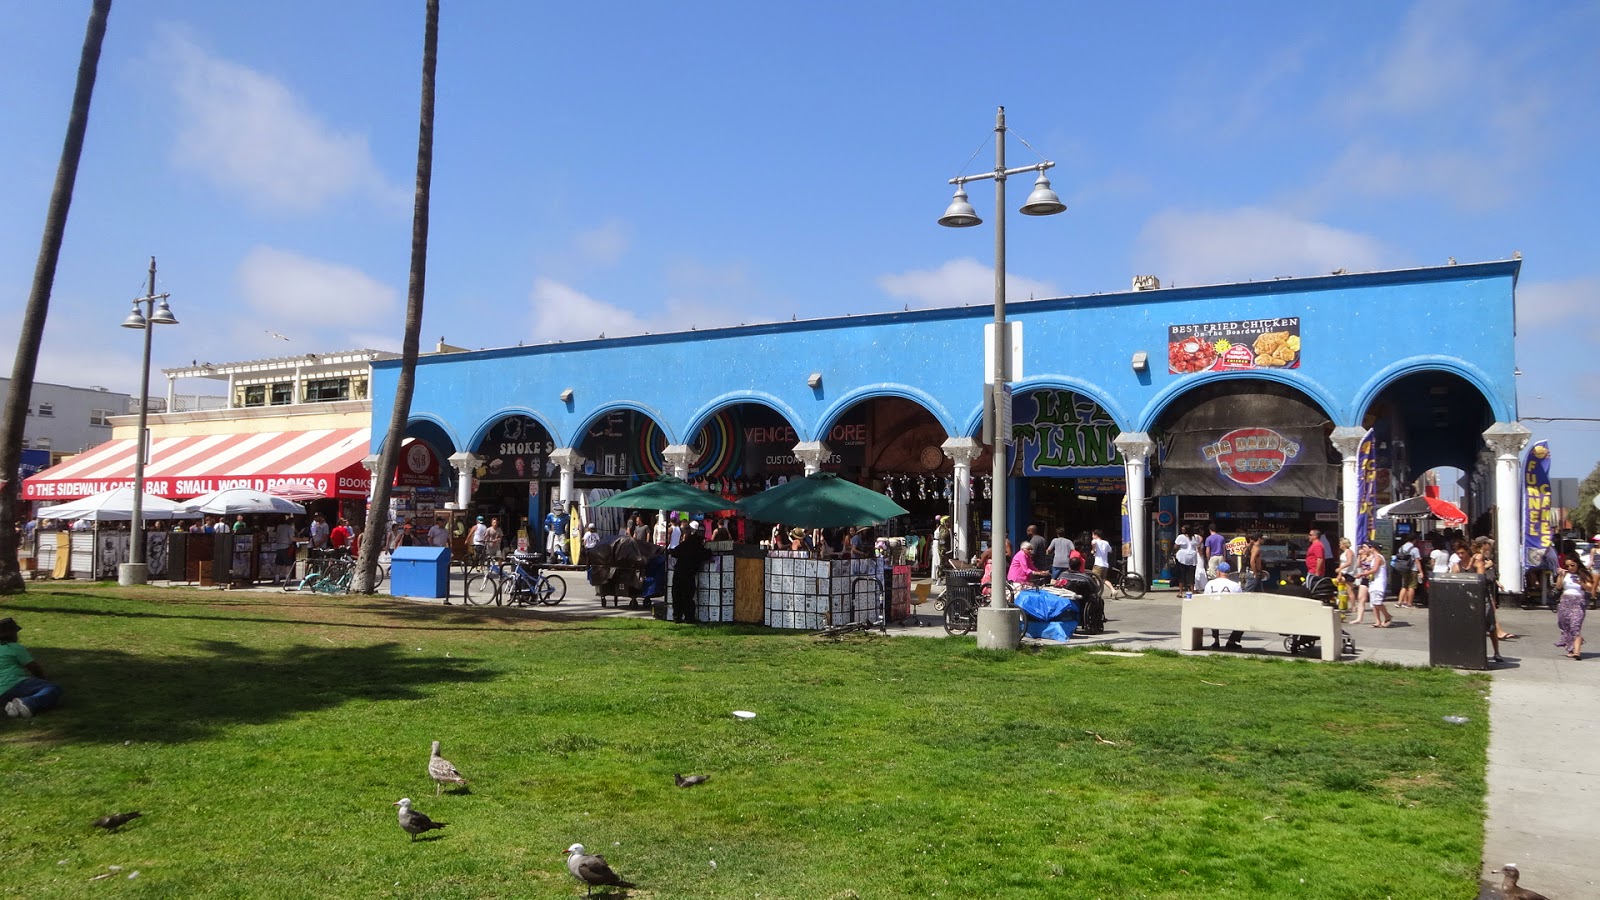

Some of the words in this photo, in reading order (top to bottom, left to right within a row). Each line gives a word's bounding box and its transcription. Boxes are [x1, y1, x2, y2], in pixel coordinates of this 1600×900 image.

[1172, 325, 1199, 334] BEST
[1203, 322, 1238, 331] FRIED
[1242, 318, 1298, 328] CHICKEN
[743, 426, 793, 442] VENICE
[500, 441, 541, 455] SMOKE
[1202, 440, 1233, 460] BIG
[1235, 457, 1282, 472] SONS
[35, 484, 55, 496] THE
[57, 482, 108, 495] SIDEWALK
[146, 481, 168, 495] BAR
[175, 479, 213, 494] SMALL
[339, 477, 371, 489] BOOKS
[1526, 461, 1541, 536] FUNNEL
[1540, 484, 1551, 547] CAKES
